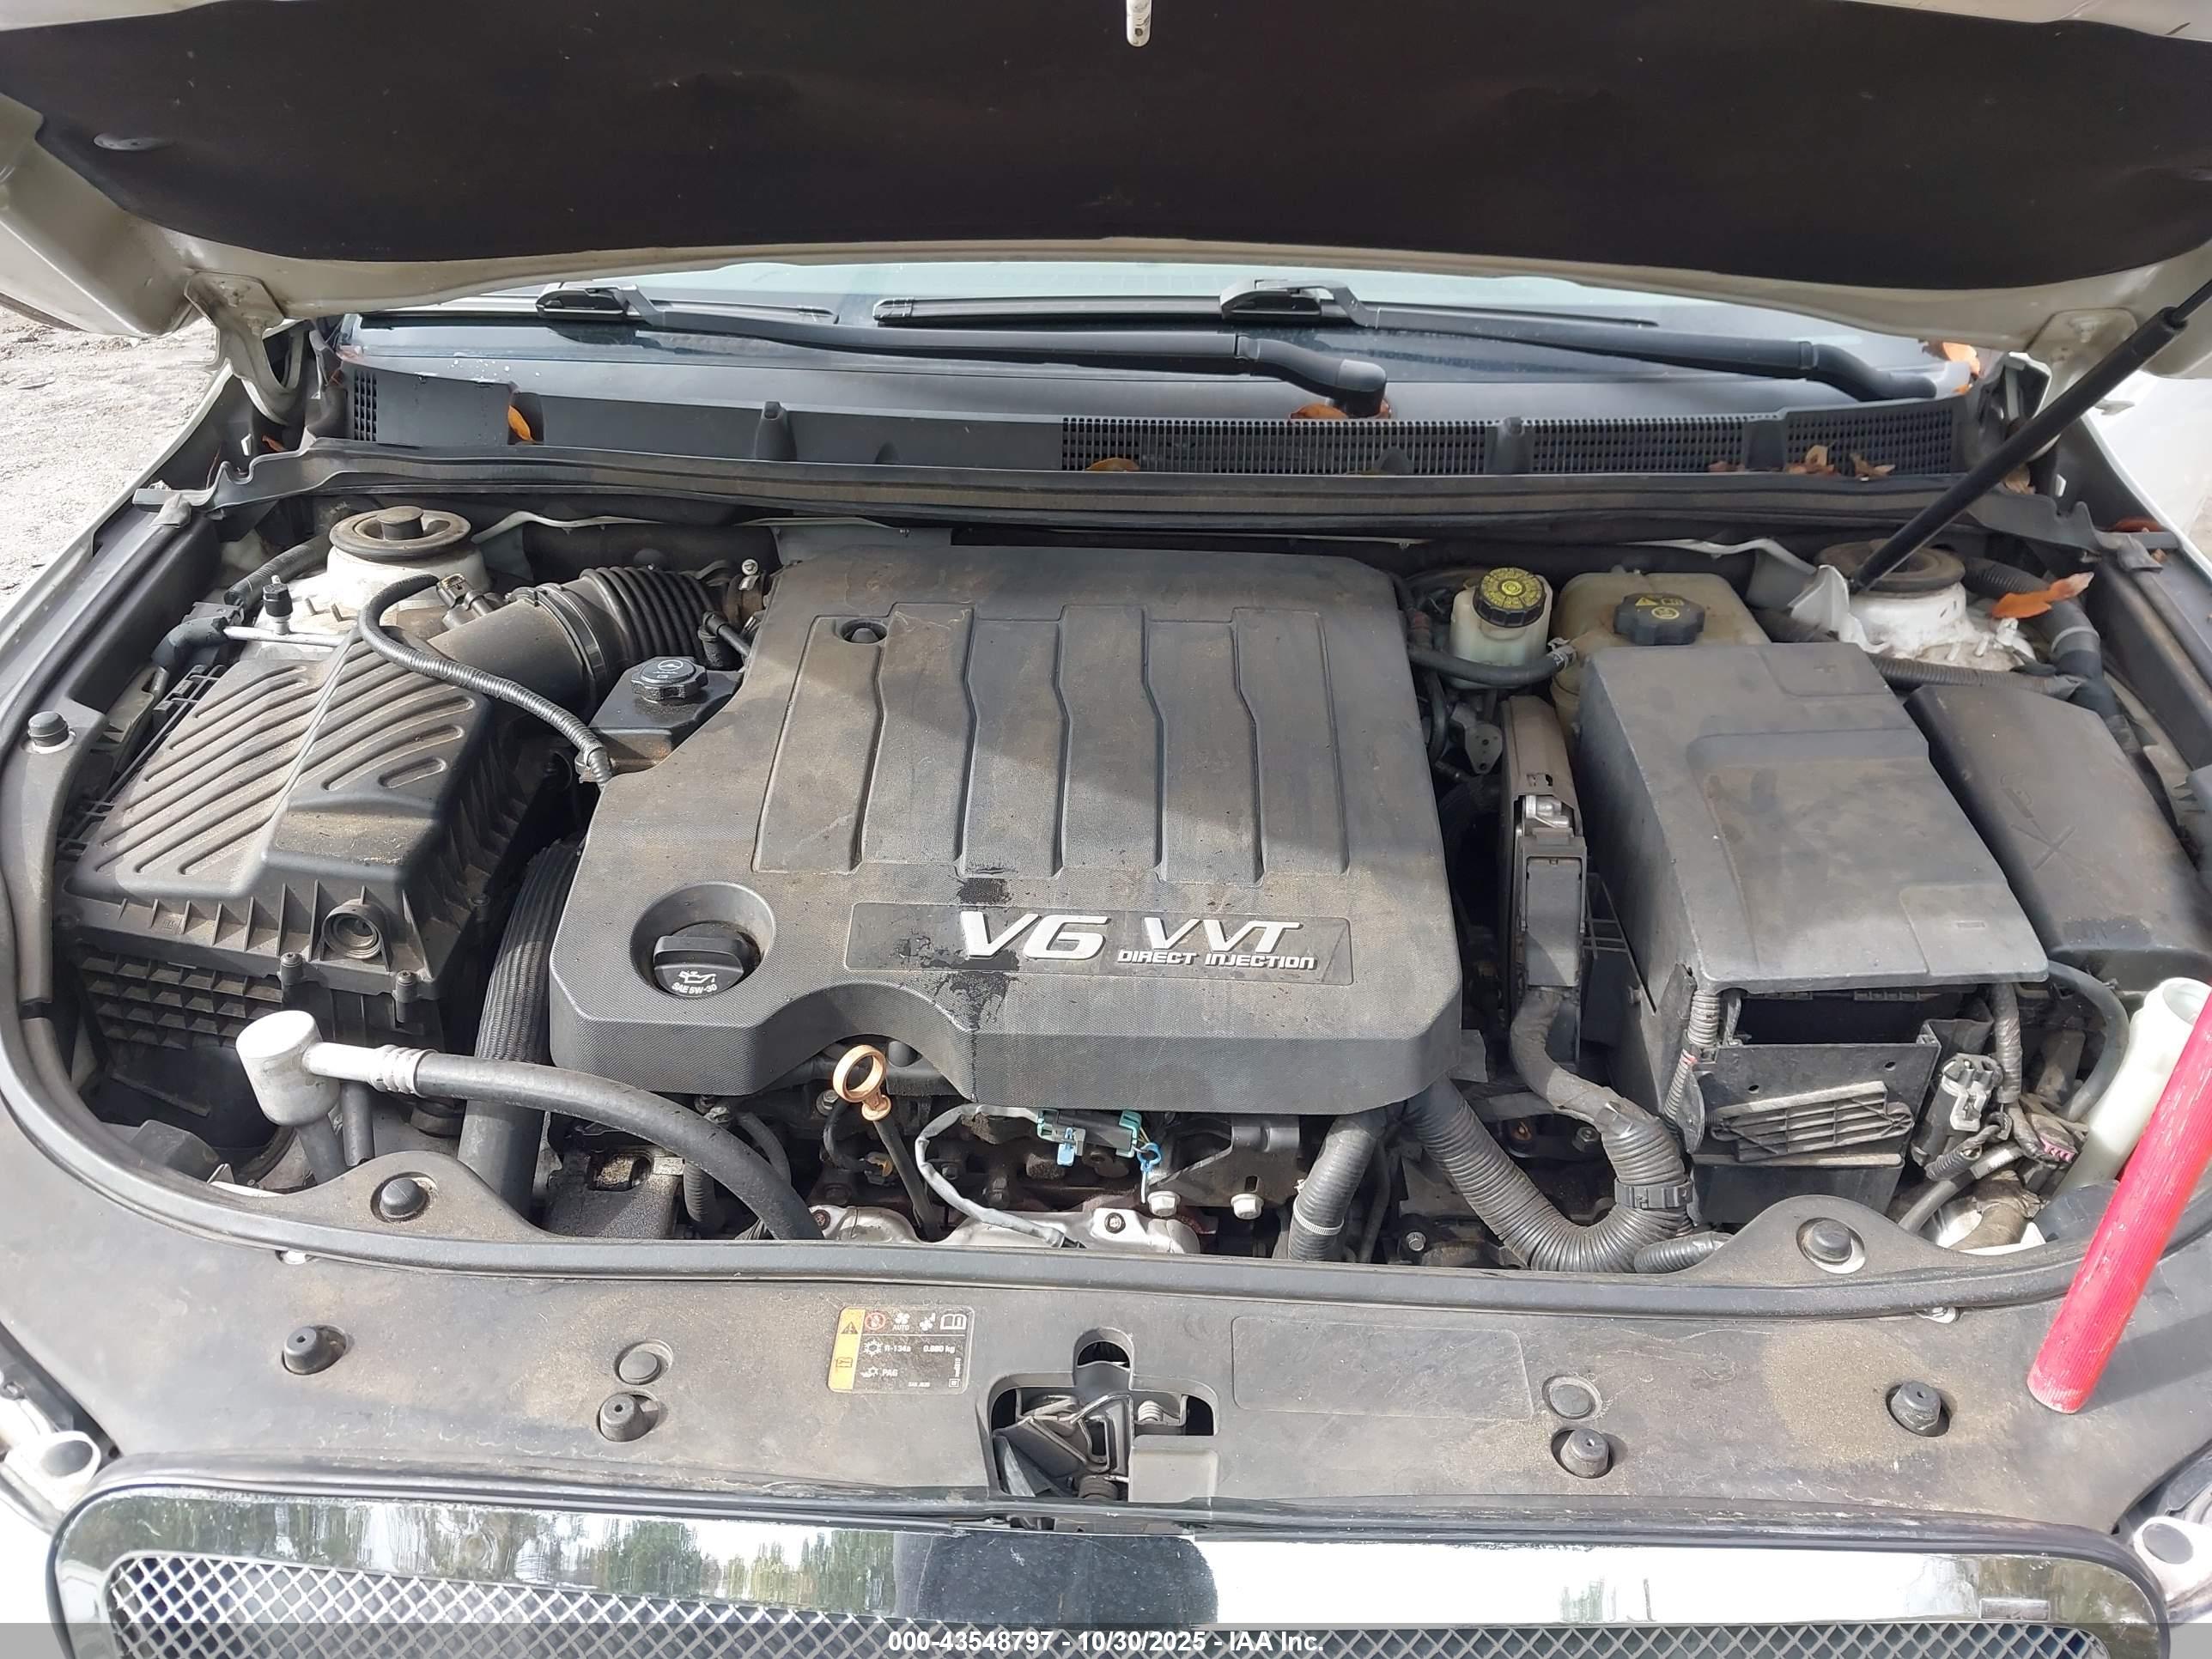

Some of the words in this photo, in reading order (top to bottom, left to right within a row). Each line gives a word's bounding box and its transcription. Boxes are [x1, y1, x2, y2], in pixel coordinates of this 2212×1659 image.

[960, 910, 1111, 961] V6
[1143, 916, 1304, 954] VVT
[1117, 949, 1199, 967] DIRECT
[1205, 952, 1317, 970] INJECTION
[672, 981, 690, 994] SAE
[689, 983, 718, 994] 5W-30
[945, 1345, 956, 1354] kg
